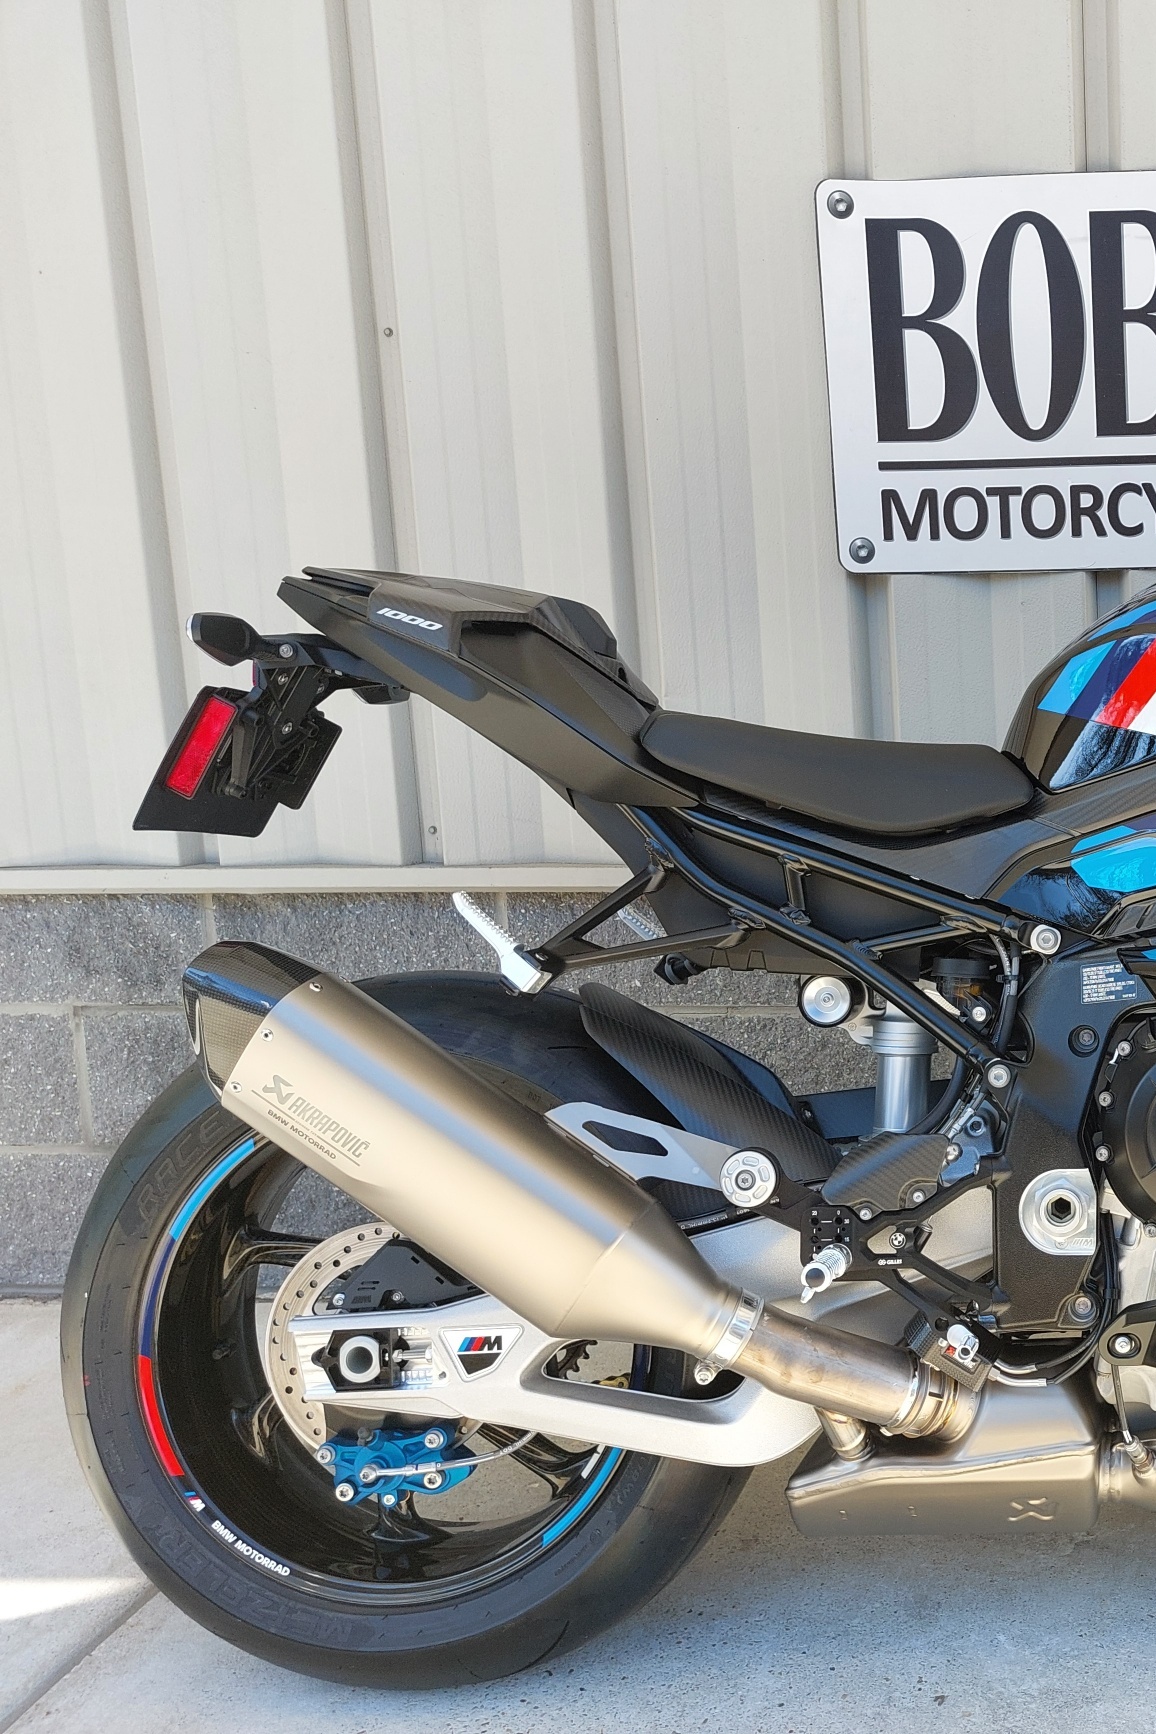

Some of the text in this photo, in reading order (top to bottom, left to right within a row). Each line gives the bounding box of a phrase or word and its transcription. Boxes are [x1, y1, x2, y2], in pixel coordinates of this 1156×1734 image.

[376, 607, 443, 631] 1000
[267, 1109, 289, 1126] BMW
[290, 1124, 337, 1160] MOTORRAD
[211, 1520, 237, 1544] BMW
[234, 1539, 291, 1576] MOTORRAD
